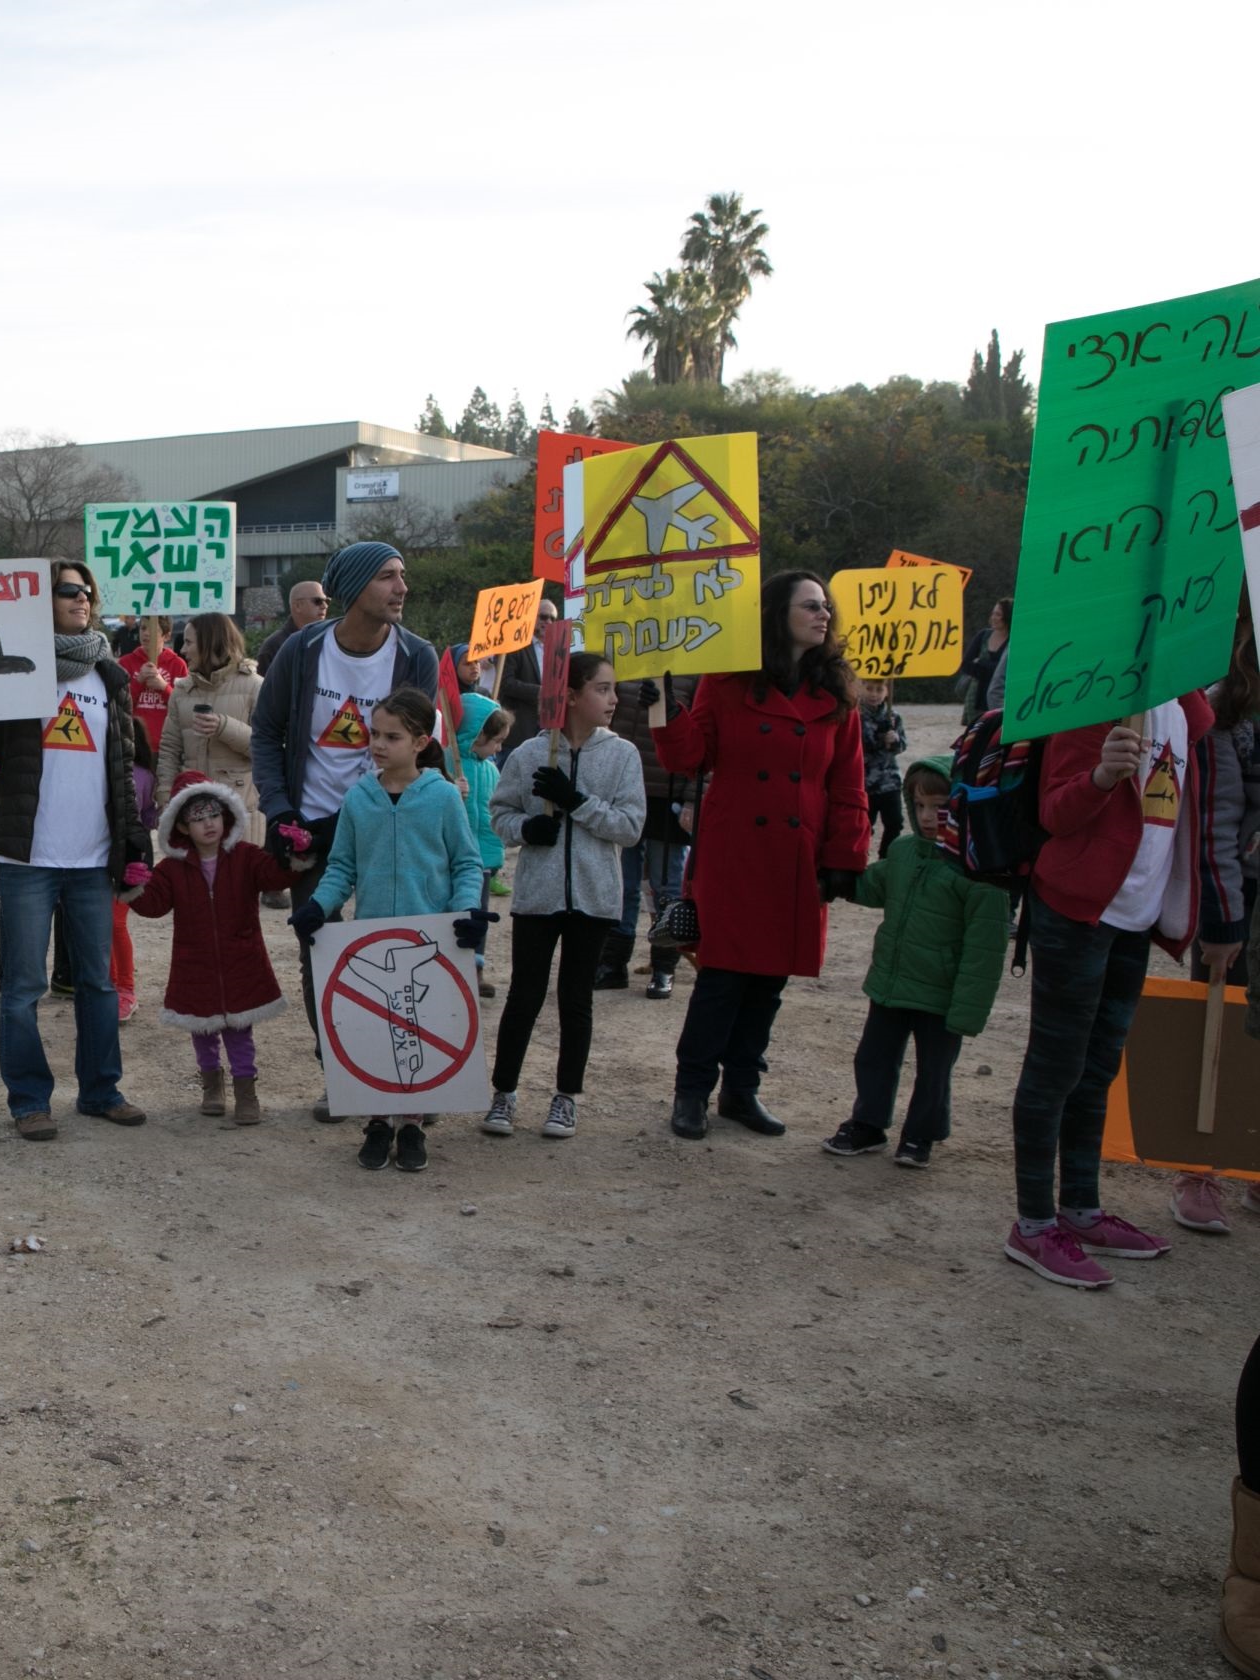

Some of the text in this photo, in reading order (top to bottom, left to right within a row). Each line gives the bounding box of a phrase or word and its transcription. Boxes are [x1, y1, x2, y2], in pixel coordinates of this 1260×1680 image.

[1067, 322, 1171, 391] ארצי
[95, 505, 231, 547] העמק
[1052, 503, 1164, 575] הוא
[94, 540, 226, 579] ישאר
[693, 556, 744, 606] לא
[858, 580, 897, 616] ניתן
[909, 572, 949, 611] לא
[1135, 555, 1227, 659] עמק
[604, 616, 723, 669] בעמק
[856, 618, 959, 656] את העמק
[1015, 640, 1149, 722] יזרעאל
